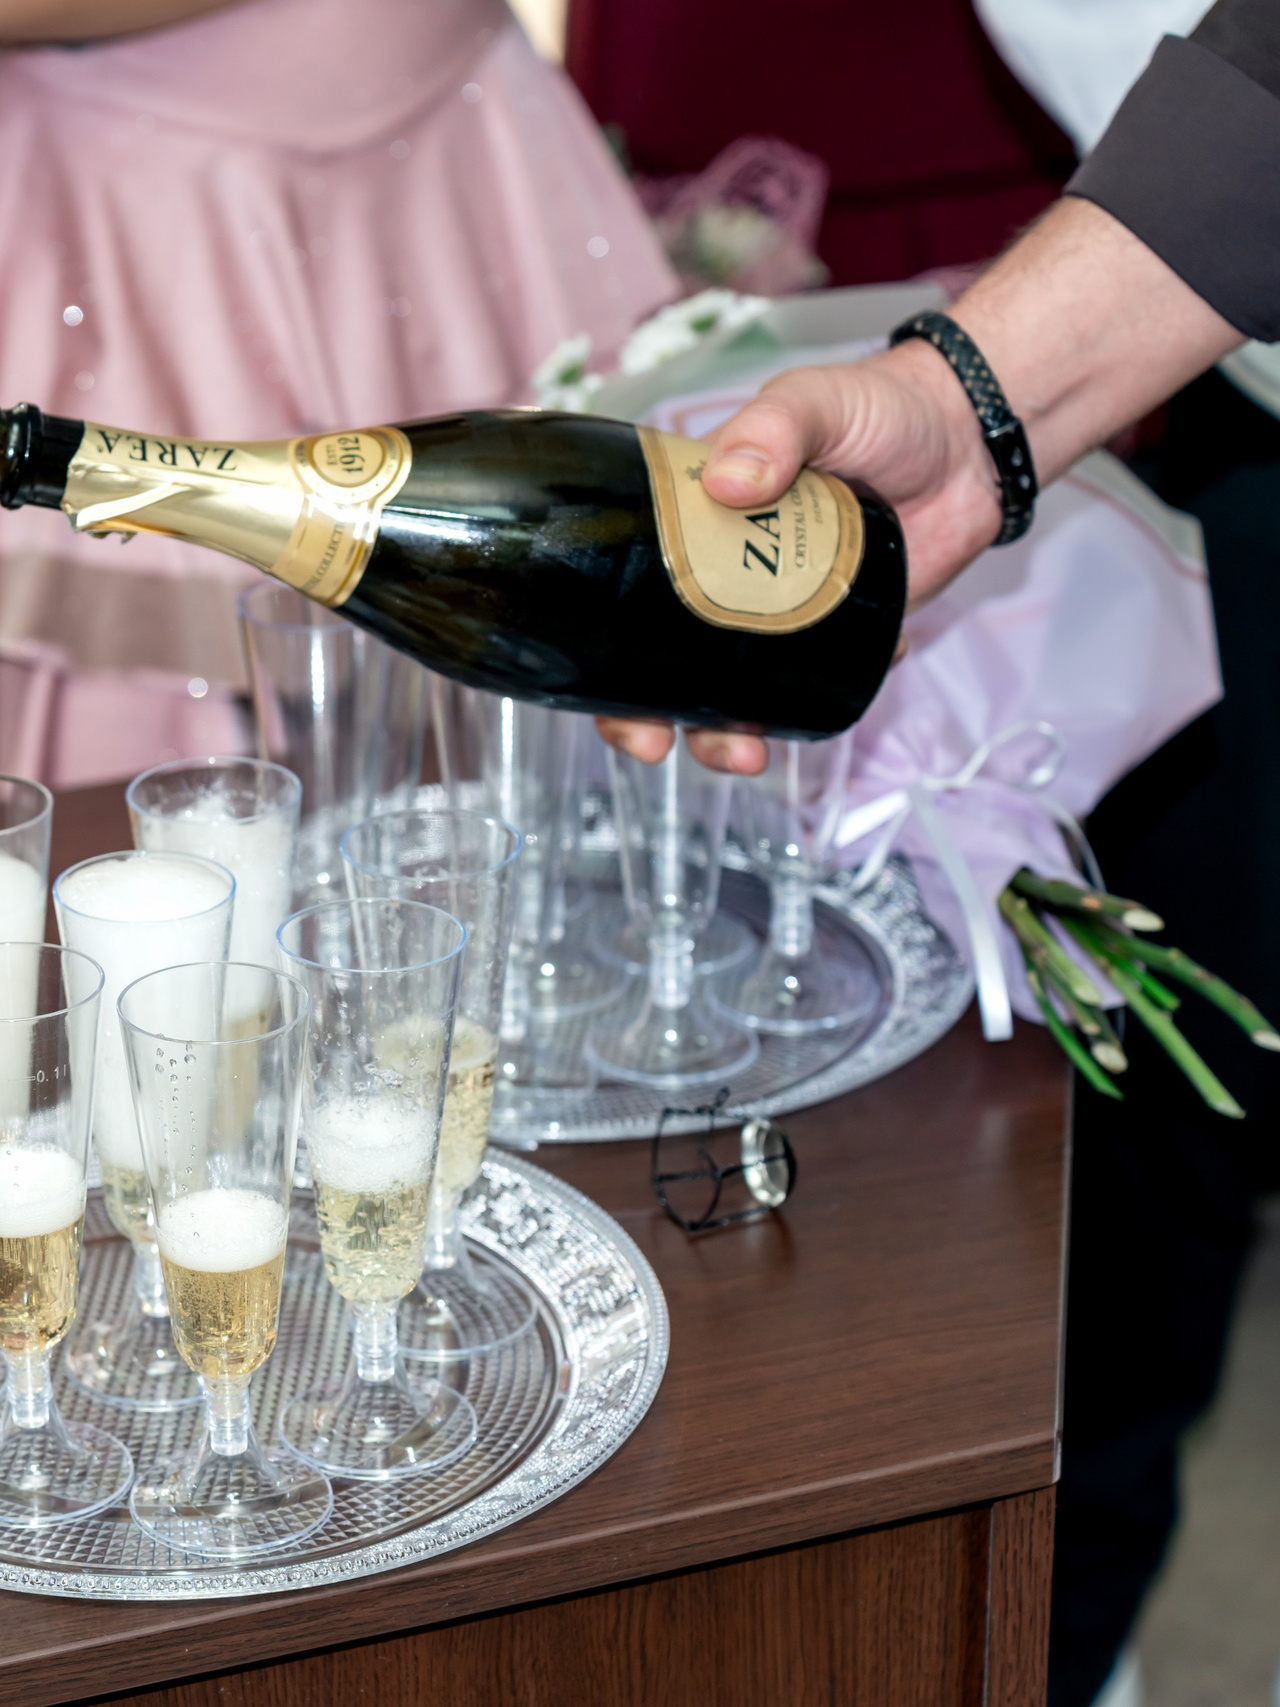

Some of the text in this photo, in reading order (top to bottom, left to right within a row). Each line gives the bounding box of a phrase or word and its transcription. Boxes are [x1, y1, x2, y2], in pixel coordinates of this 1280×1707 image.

[96, 429, 237, 471] ZAREA
[338, 436, 365, 473] 1912
[794, 510, 807, 568] CRYSTAL
